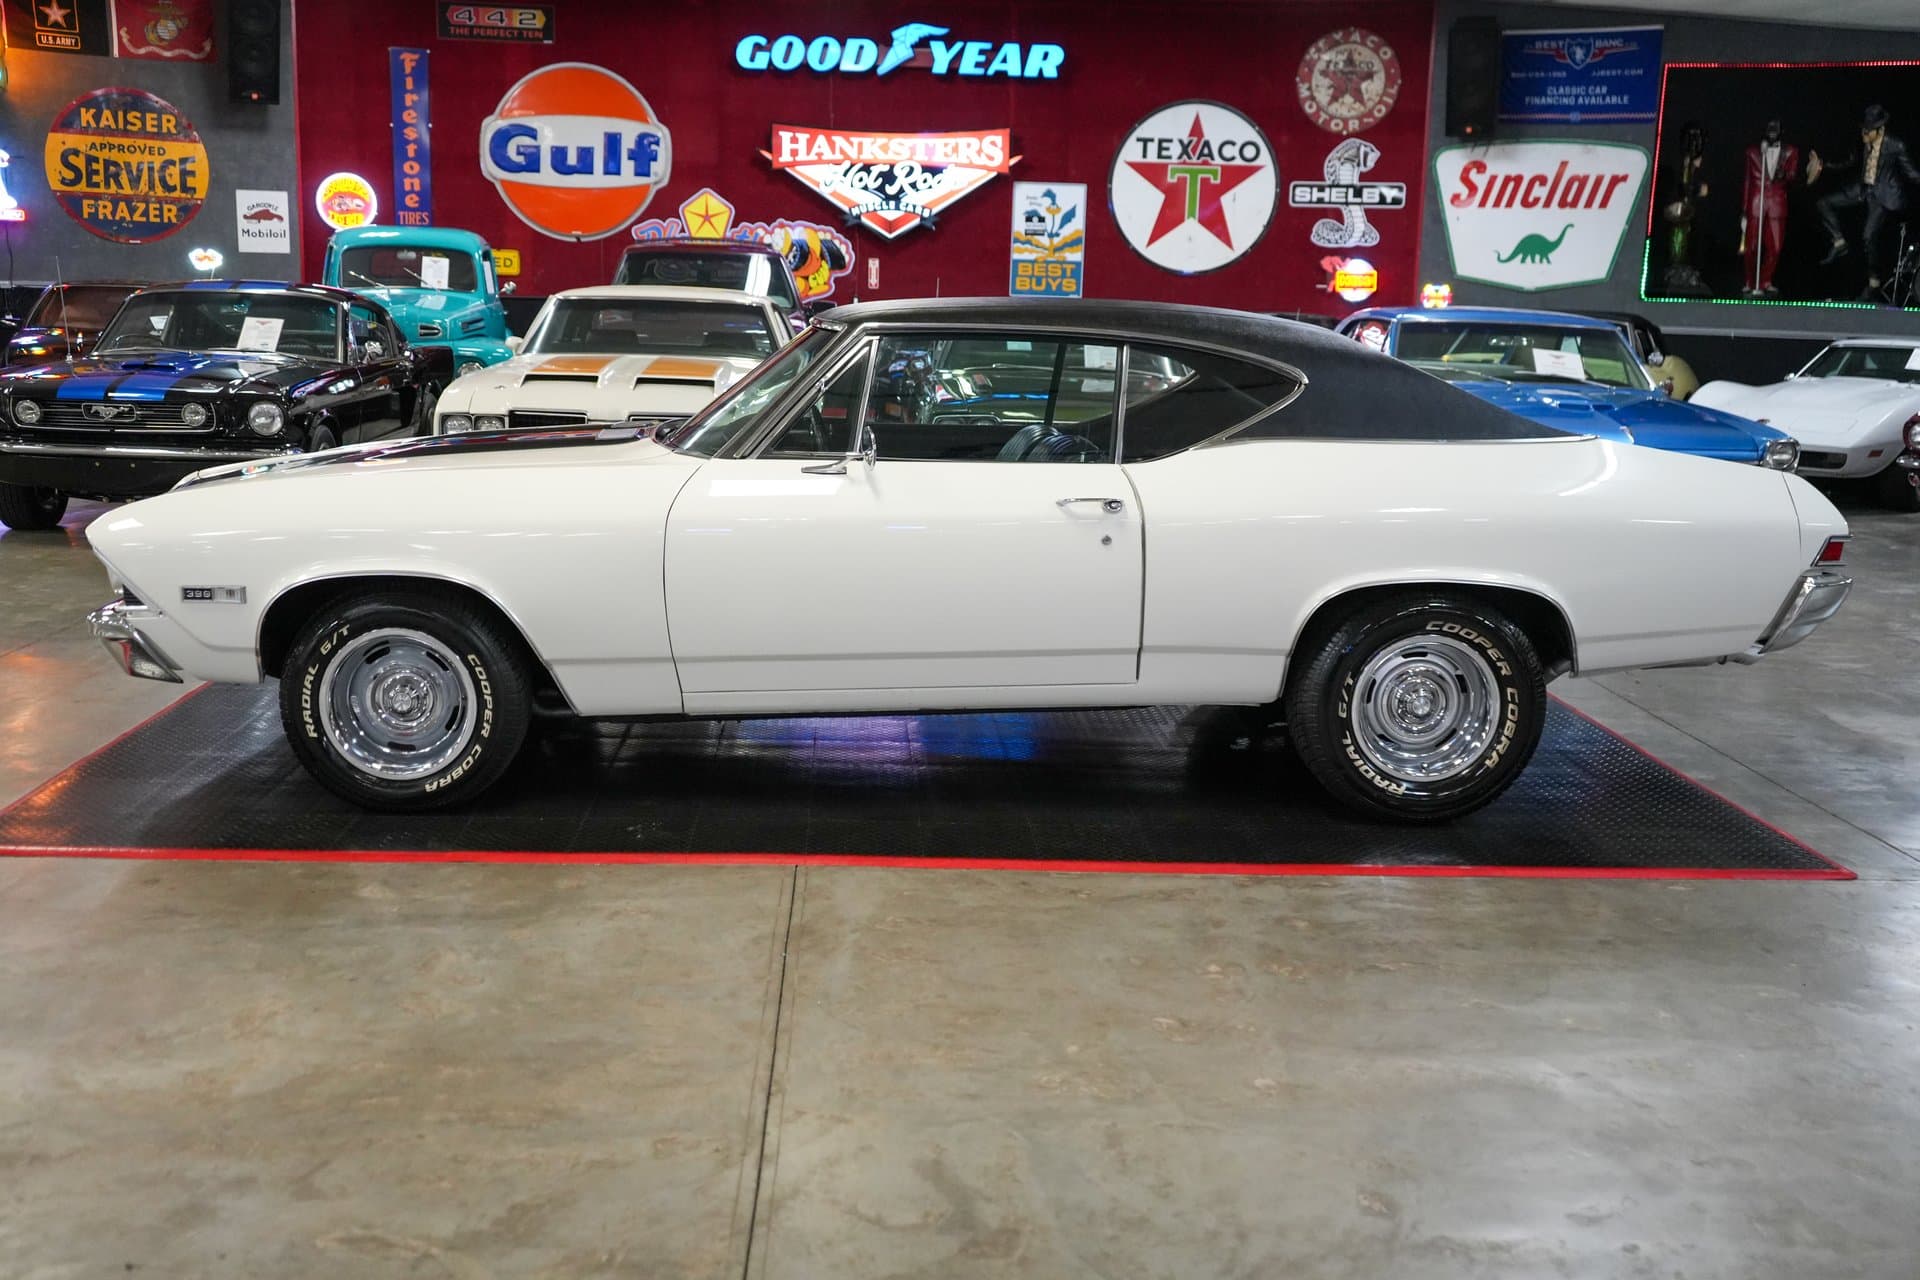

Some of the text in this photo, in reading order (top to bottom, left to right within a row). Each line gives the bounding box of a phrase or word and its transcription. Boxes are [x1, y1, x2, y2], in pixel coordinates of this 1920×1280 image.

[56, 36, 76, 46] ARMY
[450, 26, 543, 38] THE PERFECT TEN
[1525, 95, 1629, 105] FINANCING AVAILABLE
[1547, 85, 1608, 95] CLASSIC CAR
[80, 107, 177, 134] KAISER
[399, 52, 421, 208] Firestone
[89, 142, 166, 157] APPROVED
[489, 122, 661, 178] Gulf
[778, 130, 1003, 167] HANKSTERS
[1136, 137, 1261, 163] TEXACO
[60, 148, 197, 195] SERVICE
[819, 159, 890, 194] Hot
[1450, 160, 1629, 211] Sinclair
[851, 200, 931, 218] MUSCLE CARS
[1168, 165, 1221, 221] T
[1294, 186, 1400, 204] SHELBY
[83, 199, 178, 223] FRAZER
[398, 211, 429, 226] TIRES
[241, 228, 286, 238] Mobiloil
[1015, 276, 1077, 292] BUYS
[1018, 262, 1077, 278] BEST
[320, 623, 351, 655] G/T
[1426, 620, 1512, 677] COOPER
[301, 663, 319, 739] RADIAL
[467, 652, 491, 740] COOPER
[1338, 671, 1354, 718] G/T
[1485, 687, 1519, 769] COBRA
[425, 745, 482, 793] COBRA
[1342, 730, 1406, 795] RADIAL
